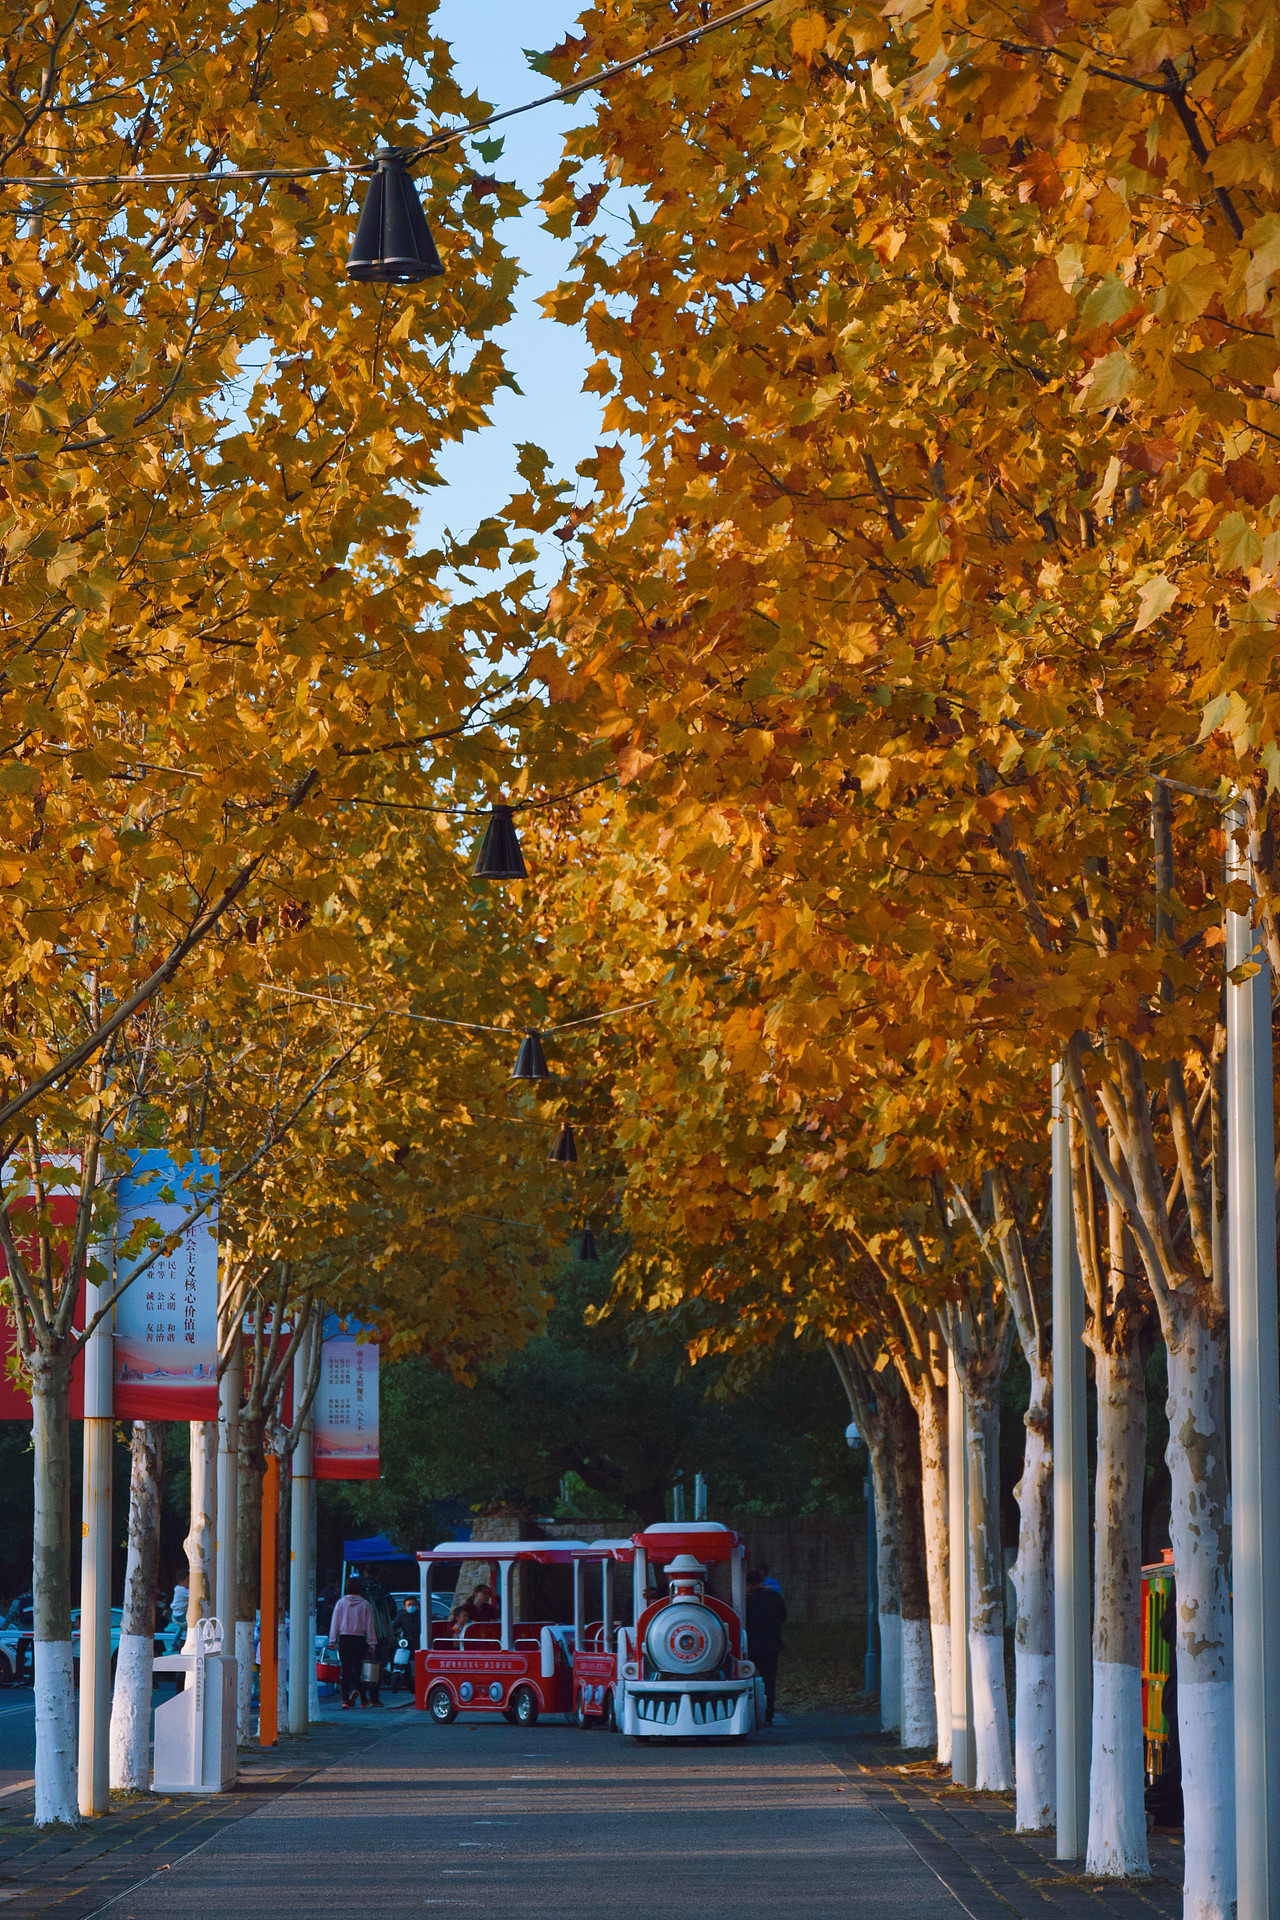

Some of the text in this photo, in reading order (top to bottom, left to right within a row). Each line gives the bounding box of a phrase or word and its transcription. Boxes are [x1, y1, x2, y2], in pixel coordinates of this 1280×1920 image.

[146, 1291, 155, 1311] 诚信
[156, 1260, 166, 1342] 平等 公正 法治
[166, 1260, 176, 1342] 民主 文明 和谐
[184, 1226, 197, 1345] 社会主义核心价值观
[145, 1322, 154, 1342] 友善
